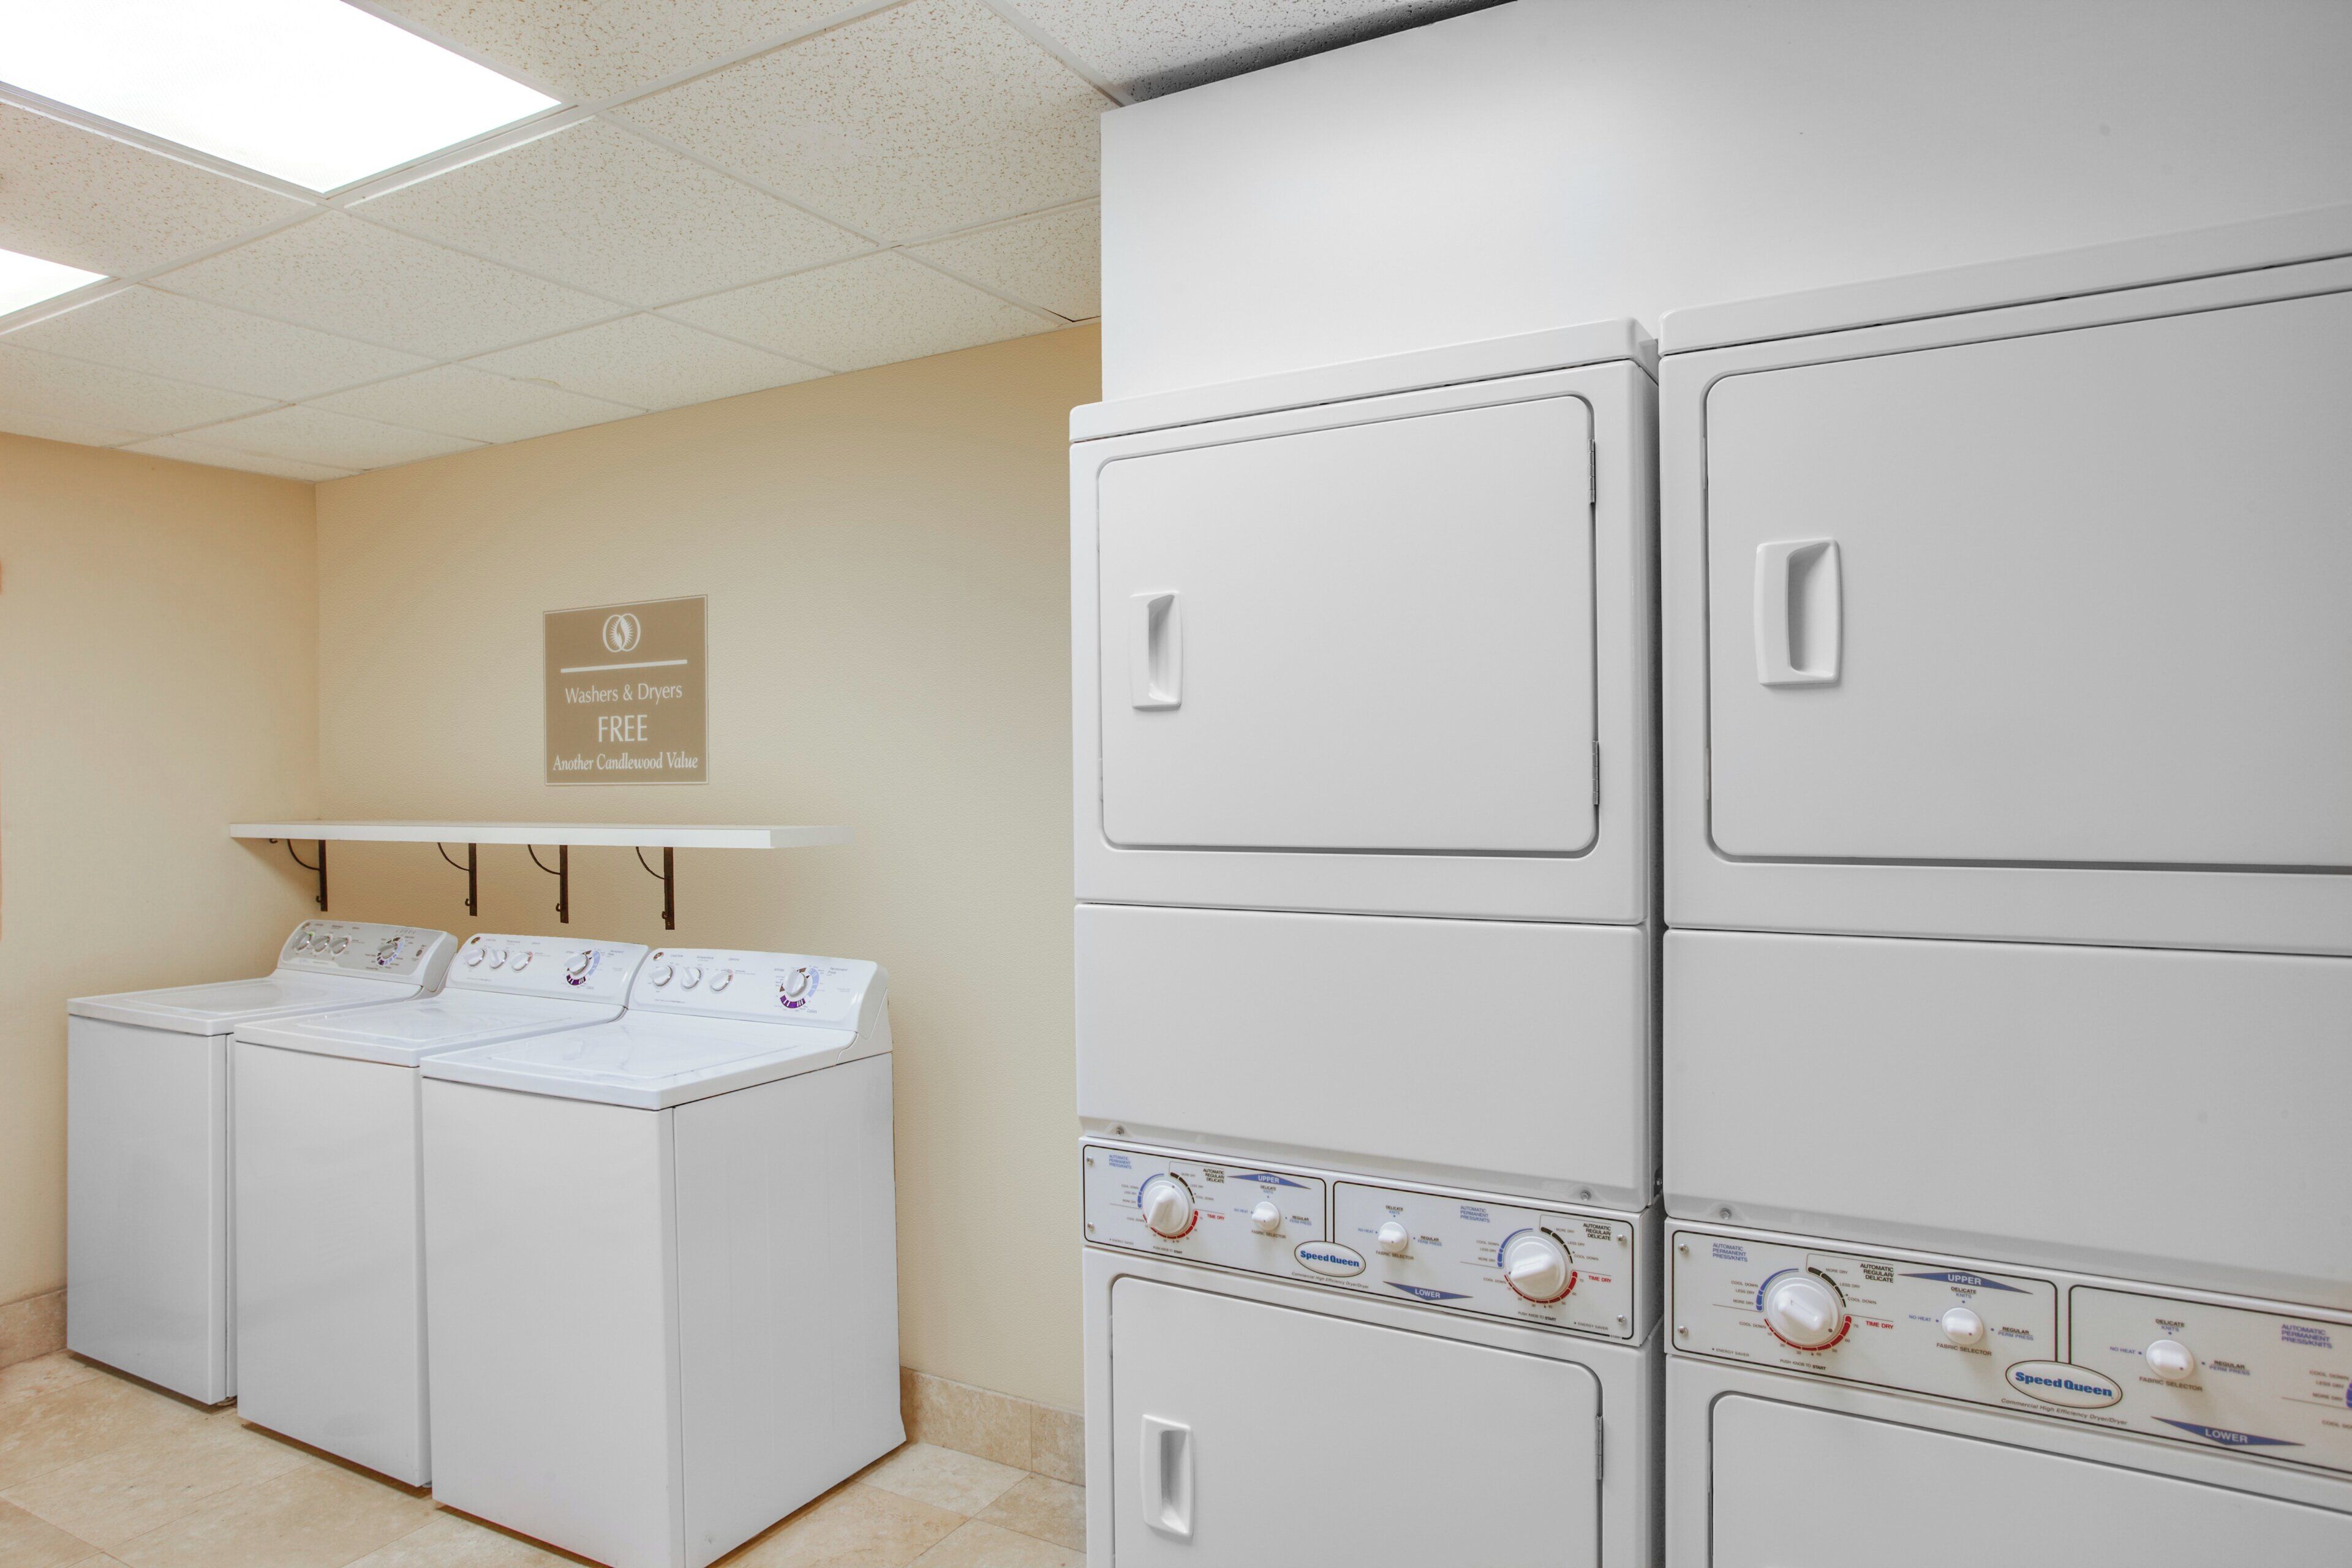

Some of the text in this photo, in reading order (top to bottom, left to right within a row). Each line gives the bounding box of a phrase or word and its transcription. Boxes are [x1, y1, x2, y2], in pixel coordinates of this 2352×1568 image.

[565, 683, 682, 704] Washers & Dryers
[598, 714, 648, 742] FREE
[552, 751, 698, 771] Another Candlewood Value
[1258, 1175, 1280, 1183] UPPER
[1460, 1215, 1490, 1223] PRESS/KNITS
[1583, 1223, 1611, 1231] AUTOMATIC
[1713, 1243, 1743, 1251] AUTOMATIC
[1713, 1248, 1746, 1256] PERMANENT
[1300, 1250, 1359, 1267] Speed Queen
[1713, 1253, 1747, 1262] PRESS/KNITS
[1860, 1263, 1893, 1272] AUTOMATIC
[1863, 1268, 1894, 1278] REGULAR/
[1865, 1275, 1893, 1283] DELICATE
[1948, 1274, 1981, 1285] UPPER
[1415, 1288, 1440, 1298] LOWER
[2155, 1319, 2185, 1327] DELICATE
[2282, 1324, 2326, 1335] AUTOMATIC
[2282, 1330, 2330, 1341] PERMANENT
[1959, 1346, 1992, 1356] SELECTOR
[2214, 1360, 2245, 1369] REGULAR
[2015, 1371, 2112, 1396] Speed Queen
[2139, 1376, 2203, 1392] FABRIC SELECTOR
[2001, 1398, 2038, 1409] Commercial
[2056, 1408, 2088, 1419] Efficiency
[2089, 1414, 2128, 1425] Dryer/Dryer
[2206, 1429, 2248, 1443] LOWER
